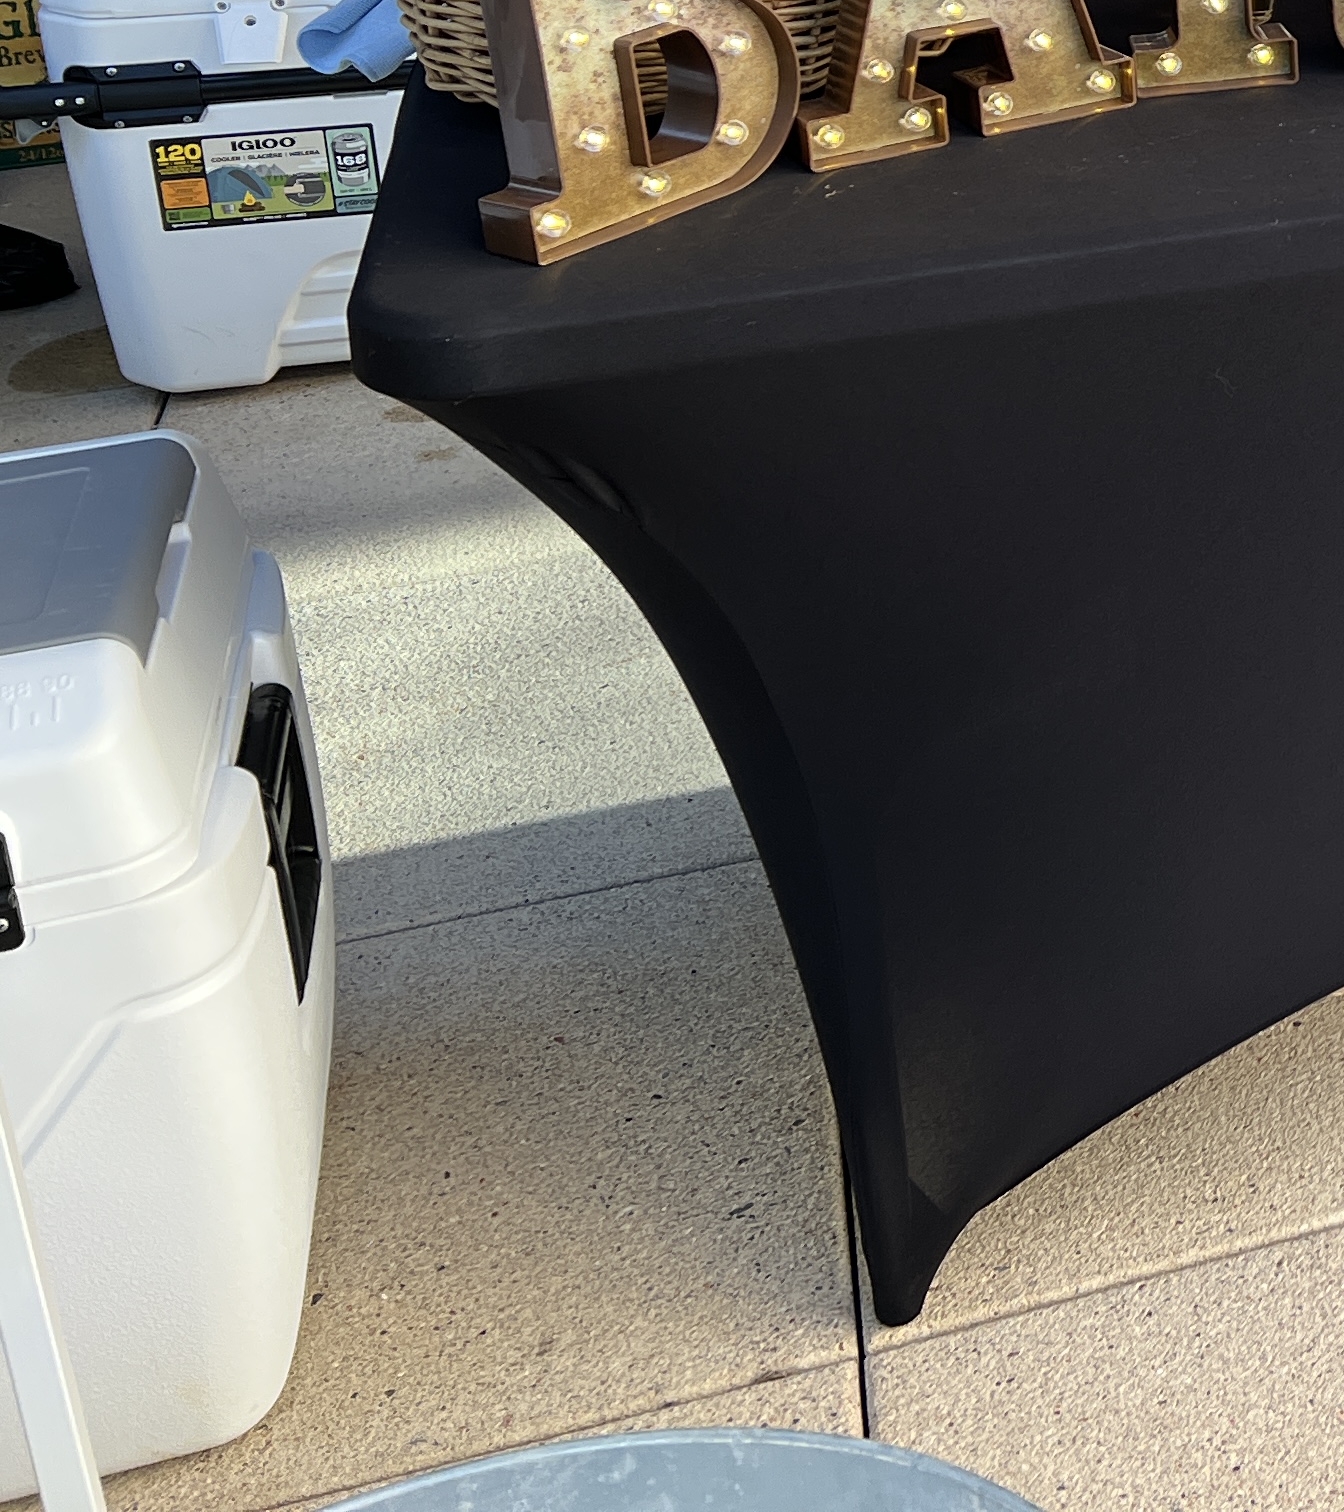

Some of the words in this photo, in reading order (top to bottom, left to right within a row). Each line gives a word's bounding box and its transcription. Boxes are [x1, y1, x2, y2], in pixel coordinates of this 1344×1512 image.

[230, 136, 296, 152] IGLOO
[155, 143, 202, 163] 120
[210, 155, 241, 163] COOLER
[336, 153, 367, 166] 168
